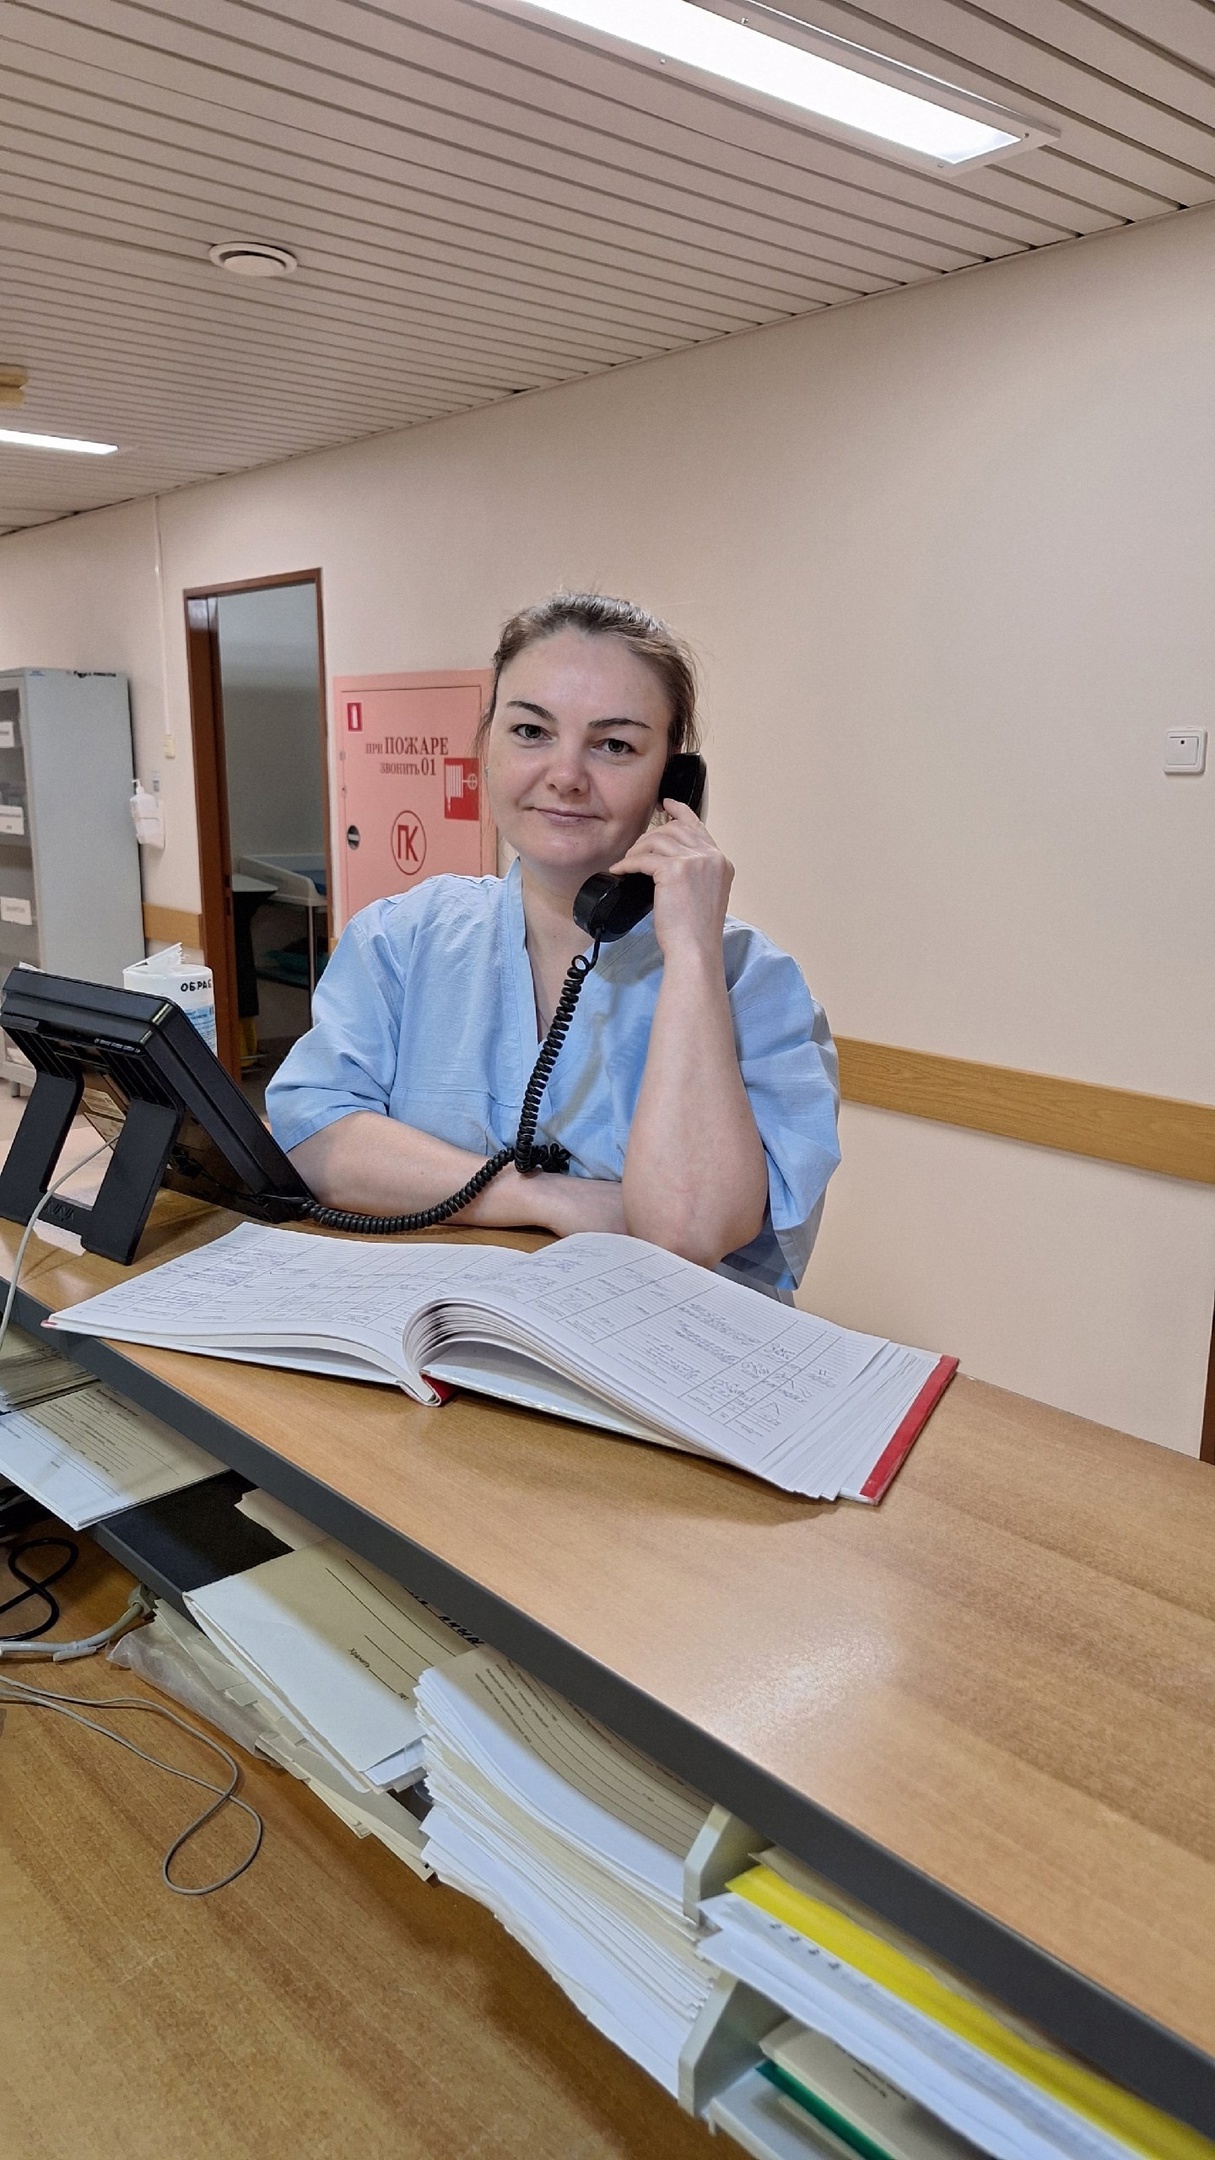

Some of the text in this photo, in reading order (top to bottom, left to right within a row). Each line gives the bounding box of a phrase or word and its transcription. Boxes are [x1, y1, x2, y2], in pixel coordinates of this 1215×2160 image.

[366, 736, 449, 755] ПРИ ПОЖАРЕ
[421, 757, 437, 776] 01
[397, 824, 419, 862] ПК
